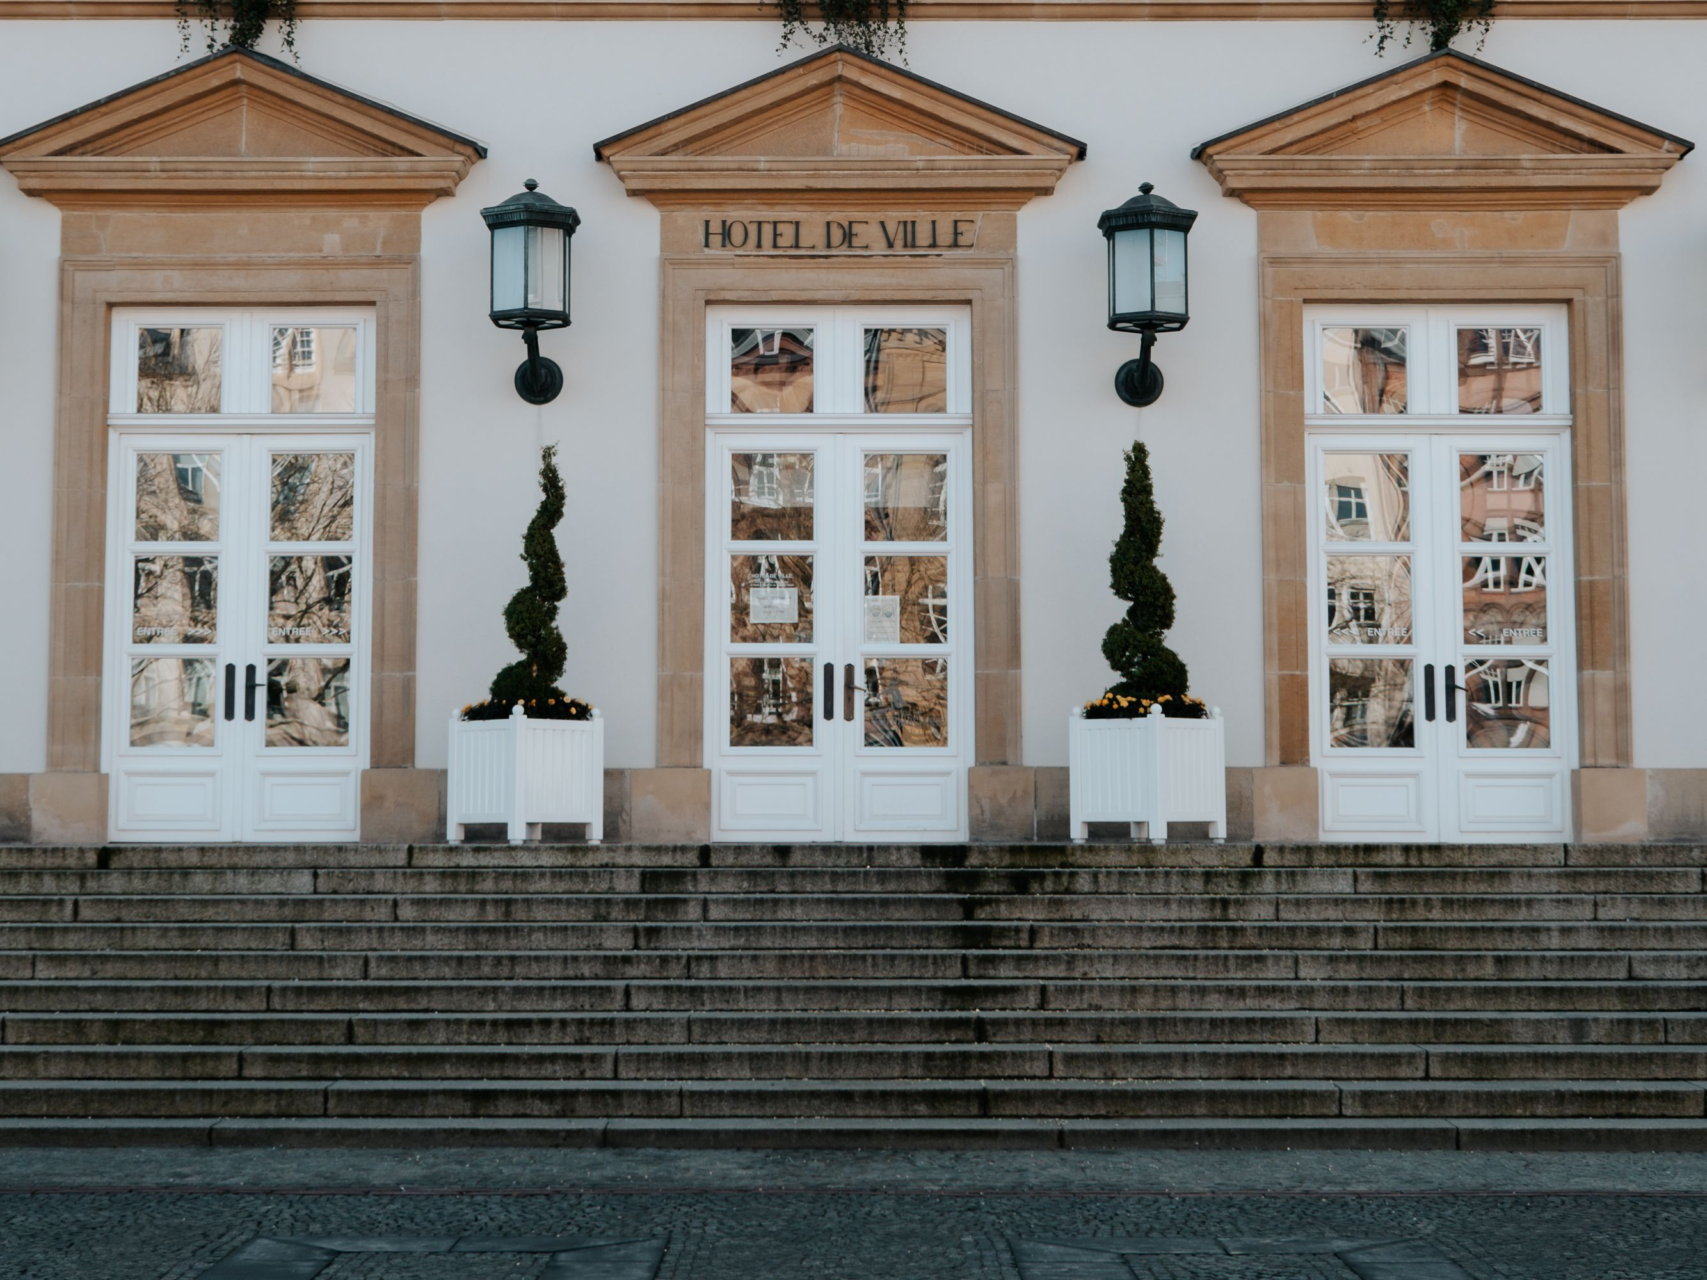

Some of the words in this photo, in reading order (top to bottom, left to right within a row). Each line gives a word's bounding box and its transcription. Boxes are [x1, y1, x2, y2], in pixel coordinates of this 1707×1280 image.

[703, 219, 815, 249] HOTEL
[825, 220, 869, 249] DE
[879, 219, 975, 249] VILLE
[1502, 628, 1543, 637] ENTREE
